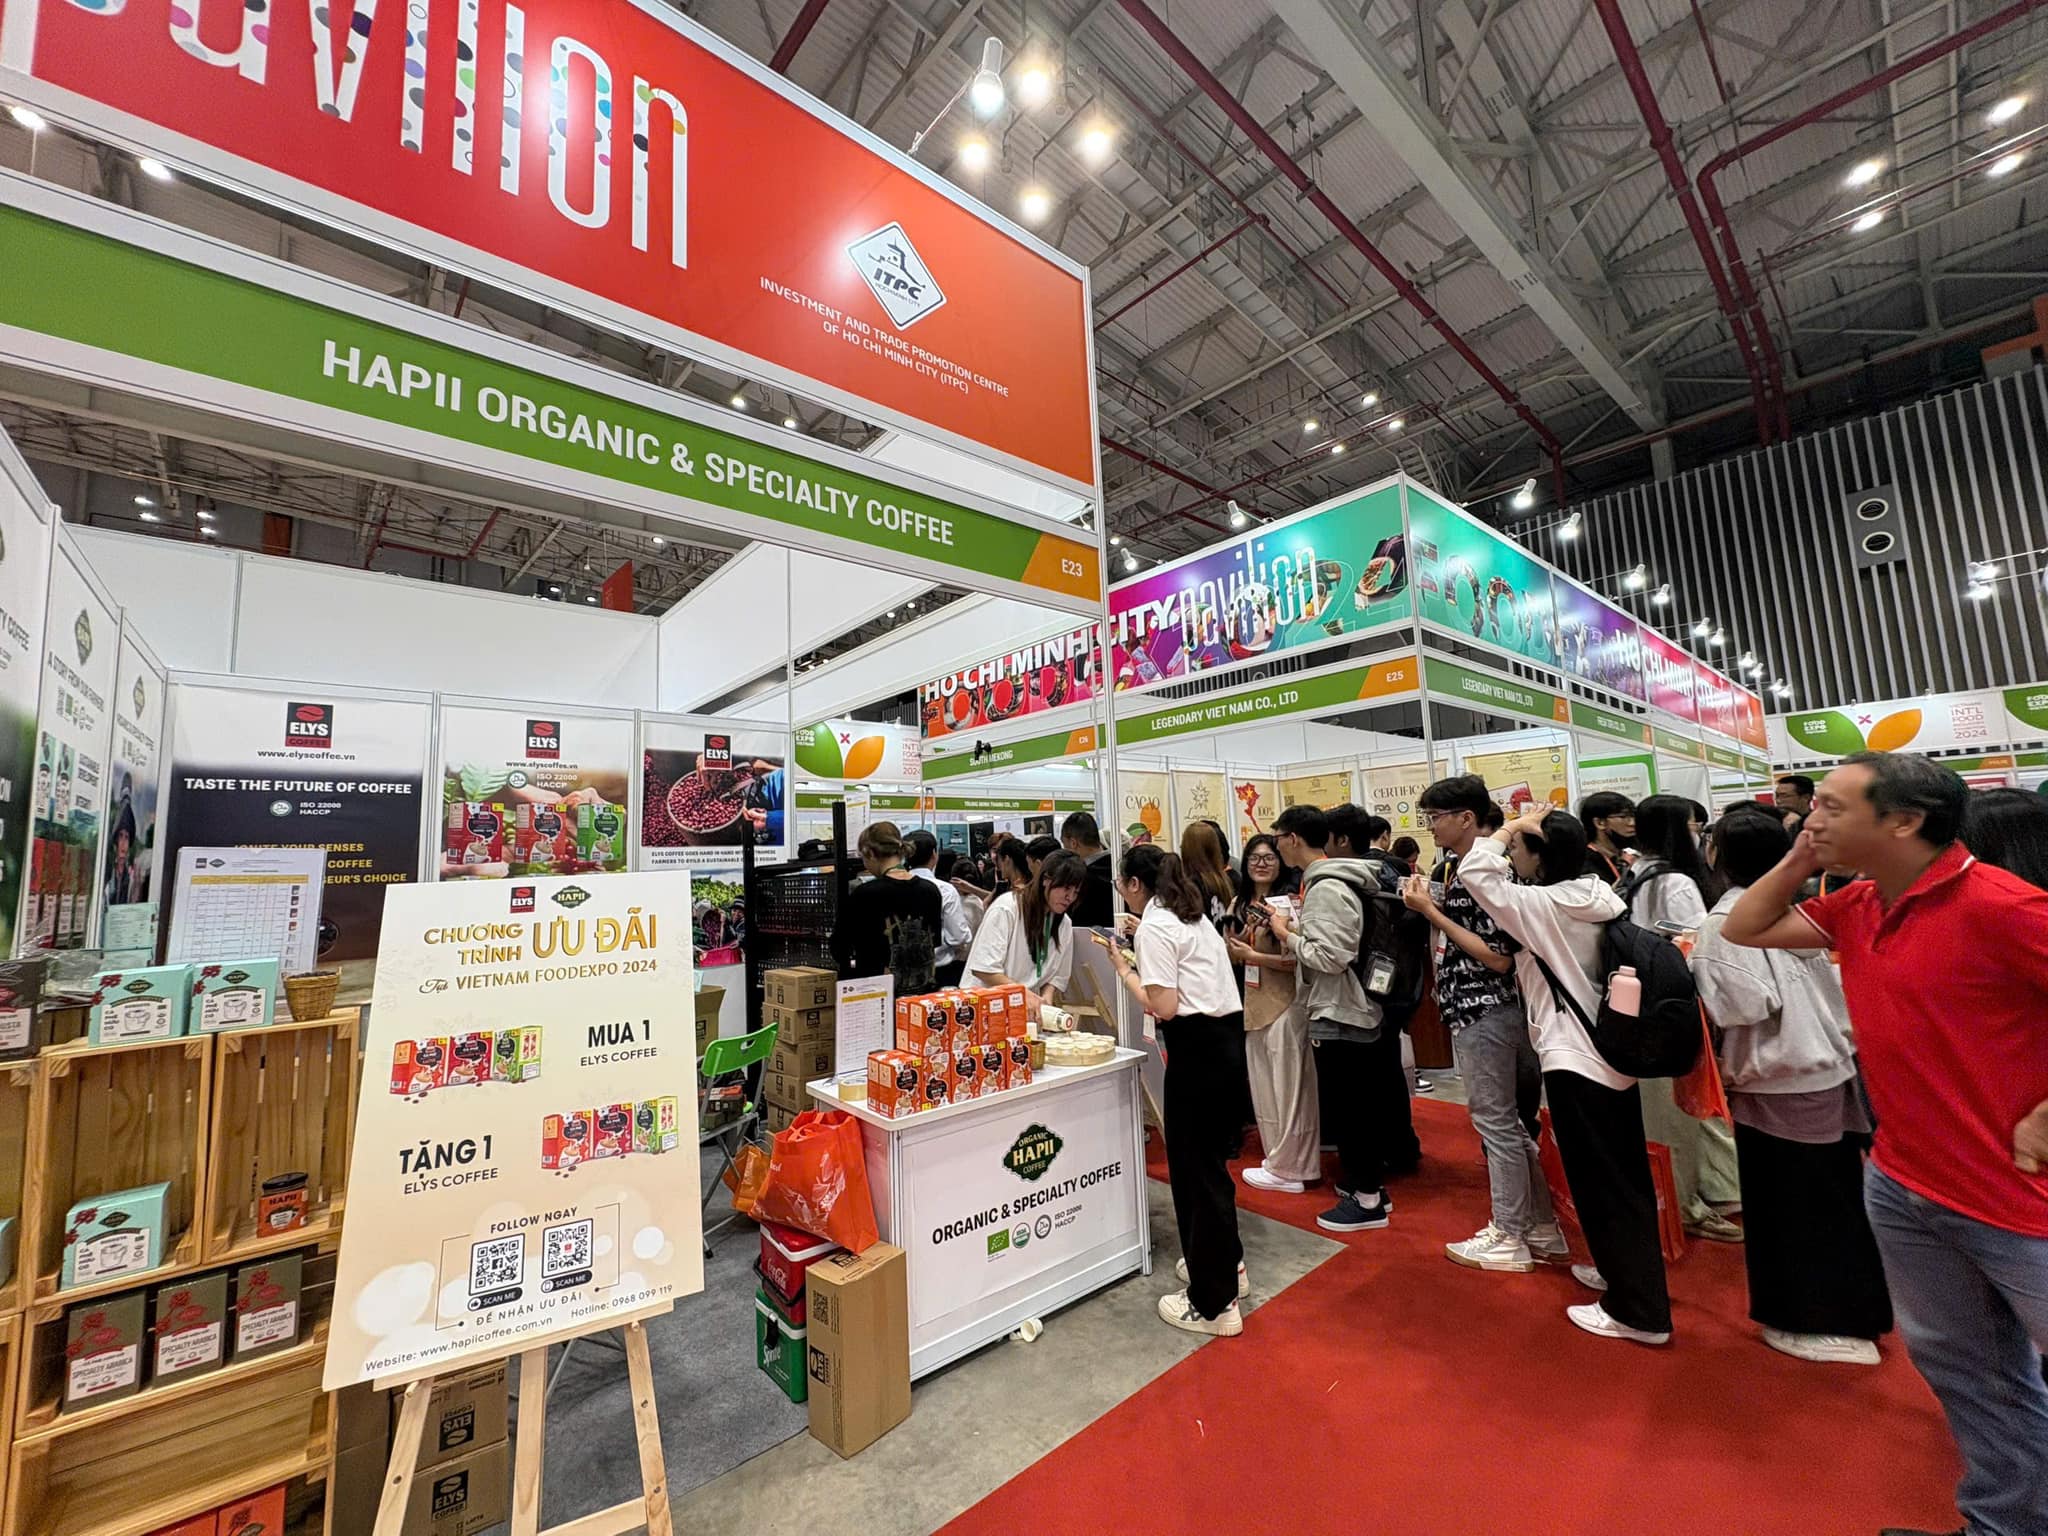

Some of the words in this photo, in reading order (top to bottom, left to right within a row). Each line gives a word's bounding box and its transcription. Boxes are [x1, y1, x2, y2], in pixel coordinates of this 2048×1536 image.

[873, 267, 923, 300] ITPC
[760, 276, 842, 322] INVESTMENT
[845, 316, 870, 335] AND
[873, 328, 909, 352] TRADE
[911, 345, 972, 381] PROMOTION
[973, 375, 1009, 397] CENTRE
[823, 321, 839, 335] OF
[842, 329, 860, 345] HO
[863, 338, 882, 356] CHI
[884, 345, 914, 368] MINH
[915, 361, 939, 380] CITY
[940, 372, 969, 395] (ITPC)
[323, 340, 462, 412] HAPII
[477, 387, 660, 465] ORGANIC
[670, 442, 695, 476] &
[705, 452, 859, 519] SPECIALTY
[866, 499, 954, 546] COFFEE
[1061, 558, 1083, 577] E23
[1179, 540, 1320, 675] pavilion
[924, 674, 958, 704] HO
[963, 657, 1005, 690] CHI
[1011, 628, 1089, 676] MINH
[1386, 671, 1404, 682] E25
[1151, 709, 1203, 731] LEGENDARY
[1206, 705, 1228, 721] VIET
[1229, 700, 1254, 715] NAM
[1255, 696, 1277, 711] CO.,
[1279, 691, 1299, 705] LTD
[289, 721, 329, 737] ELYS
[1954, 729, 1988, 740] 2024
[528, 736, 558, 749] ELYS
[257, 750, 356, 761] www.elyscoffee.vn
[706, 749, 729, 760] ELYS
[184, 777, 237, 790] TASTE
[239, 779, 271, 791] THE
[274, 780, 333, 793] FUTURE
[336, 782, 356, 793] OF
[358, 782, 412, 794] COFFEE
[318, 843, 364, 853] SENSES
[327, 859, 373, 869] COFFEE
[364, 873, 408, 883] CHOICE
[511, 897, 534, 907] ELYS
[557, 891, 586, 902] HAPII
[423, 922, 524, 945] CHƯƠNG
[532, 915, 586, 959] ƯU
[594, 907, 657, 953] ĐÃI
[457, 943, 523, 966] TRÌNH
[456, 968, 529, 990] VIETNAM
[535, 961, 618, 983] FOODEXPO
[622, 958, 657, 974] 2024
[588, 1024, 635, 1048] MUA
[642, 1020, 651, 1041] 1
[580, 1052, 609, 1067] ELYS
[610, 1047, 658, 1063] COFFEE
[1017, 1131, 1049, 1148] ORGANIC
[399, 1139, 477, 1179] TẶNG
[483, 1135, 493, 1160] 1
[1012, 1138, 1055, 1167] HAPII
[1022, 1160, 1047, 1174] COFFEE
[403, 1177, 438, 1195] ELYS
[441, 1167, 499, 1188] COFFEE
[932, 1207, 999, 1246] ORGANIC
[1001, 1203, 1011, 1220] &
[1013, 1177, 1079, 1216] SPECIALTY
[1080, 1161, 1122, 1189] COFFEE
[490, 1214, 540, 1234] FOLLOW
[544, 1206, 579, 1223] NGAY
[1054, 1211, 1066, 1221] ISO
[1054, 1216, 1077, 1230] HACCP
[575, 1272, 587, 1283] ME
[498, 1303, 535, 1322] NHẬN
[539, 1296, 557, 1310] ƯU
[561, 1291, 583, 1304] ĐÃI
[504, 1290, 516, 1301] ME
[571, 1300, 611, 1319] Hotline:
[611, 1294, 637, 1309] 0968
[638, 1288, 658, 1302] 099
[658, 1283, 674, 1296] 119
[365, 1350, 418, 1373] Website:
[419, 1315, 554, 1359] www.hapiicoffee.com.vn
[816, 1352, 826, 1382] ELYS
[442, 1412, 473, 1434] ELYS
[434, 1488, 466, 1511] ELYS
